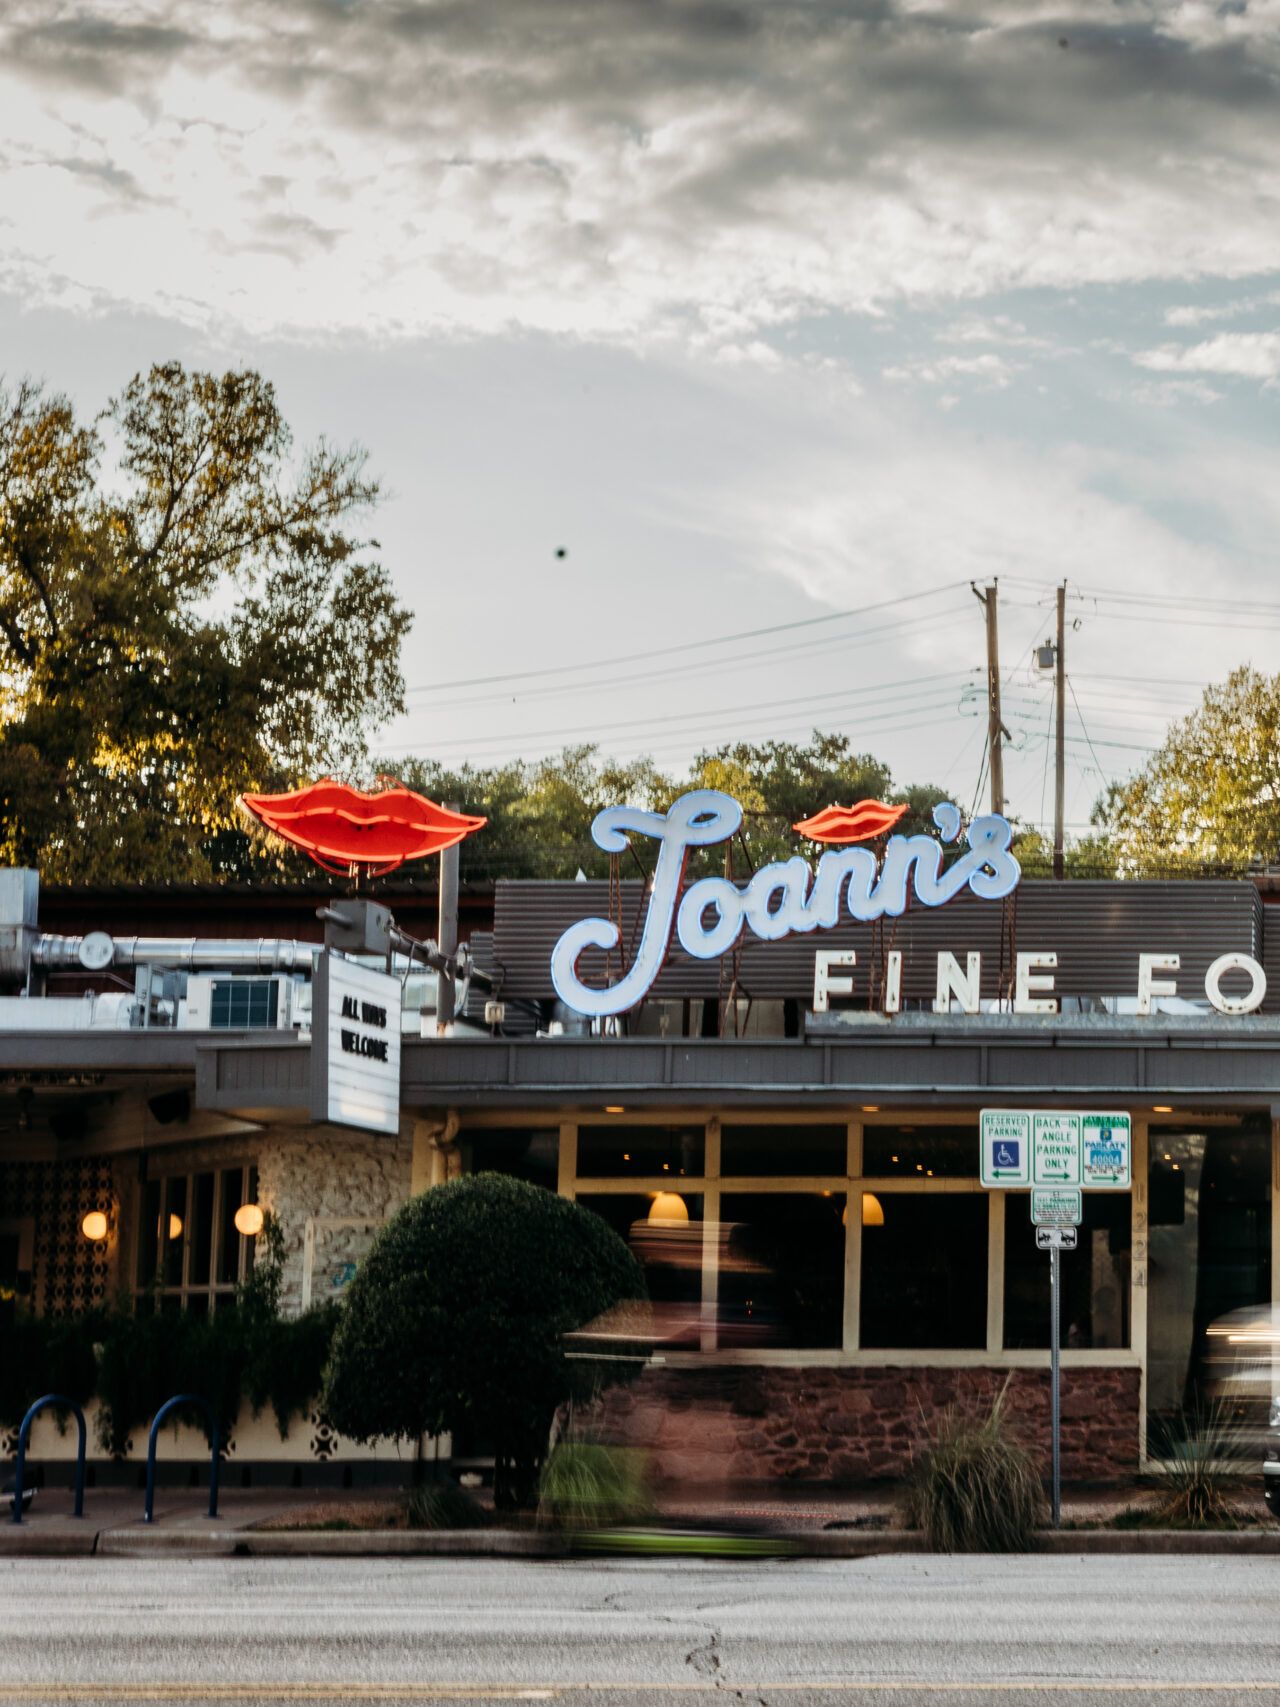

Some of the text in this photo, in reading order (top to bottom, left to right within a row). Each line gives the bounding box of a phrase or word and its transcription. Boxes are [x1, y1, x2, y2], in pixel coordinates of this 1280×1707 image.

[550, 789, 1021, 1016] Joann's
[813, 950, 1058, 1014] FINE
[342, 995, 360, 1020] ALL
[341, 1028, 388, 1063] WELCOME
[985, 1116, 1026, 1126] RESERVED
[988, 1127, 1023, 1136] PARKING
[1042, 1131, 1071, 1141] ANGLE
[1036, 1145, 1076, 1155] PARKING
[1045, 1159, 1068, 1169] ONLY
